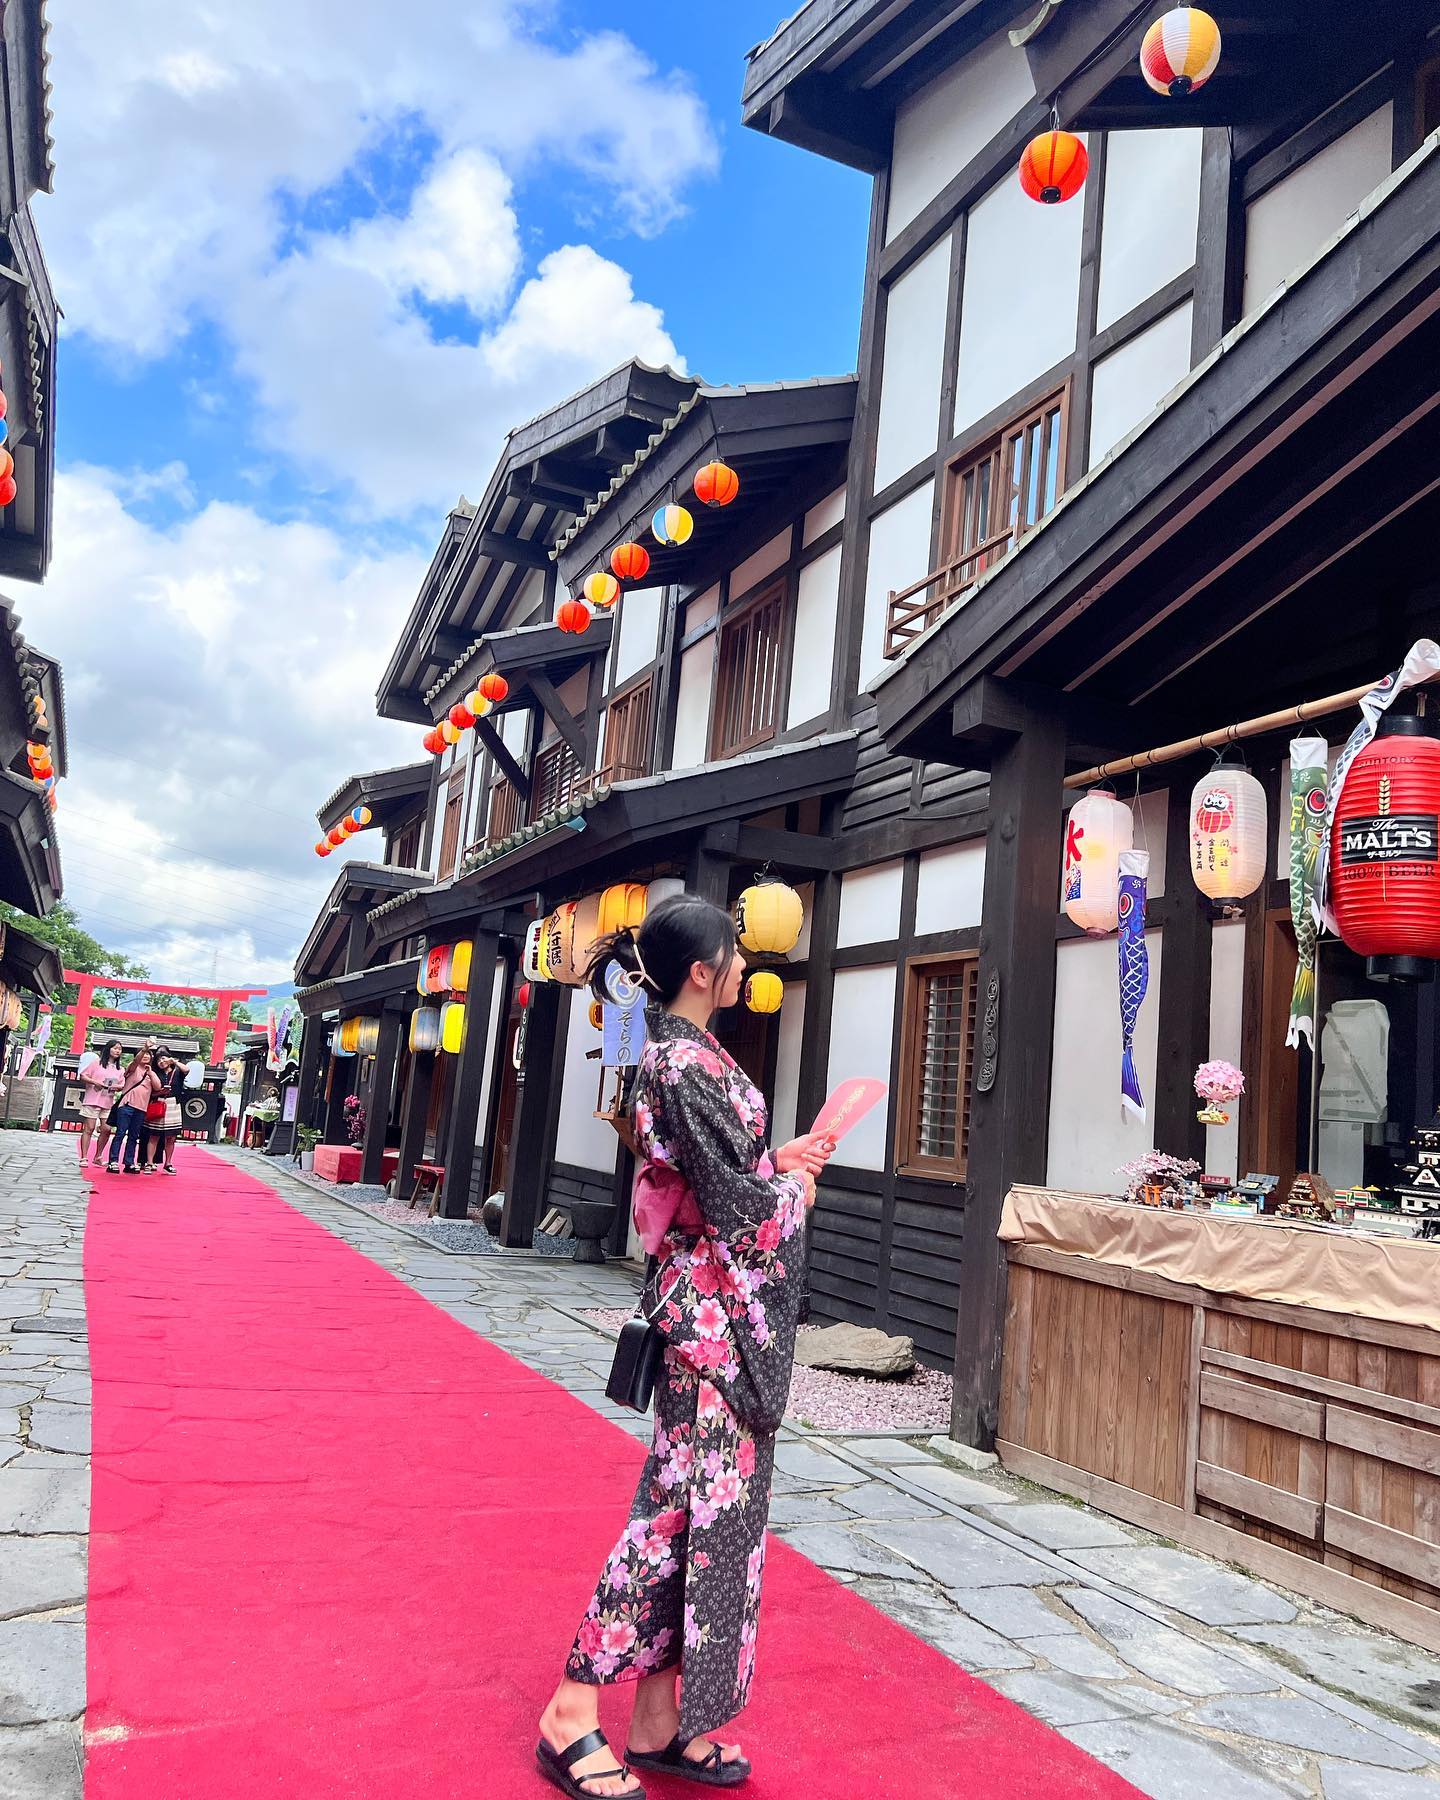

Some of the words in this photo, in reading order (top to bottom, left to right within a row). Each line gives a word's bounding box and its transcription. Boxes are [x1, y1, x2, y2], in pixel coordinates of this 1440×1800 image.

[1369, 818, 1400, 831] The
[1345, 827, 1432, 851] MALT'S
[1388, 864, 1435, 877] BEER
[616, 1010, 634, 1064] そらの
